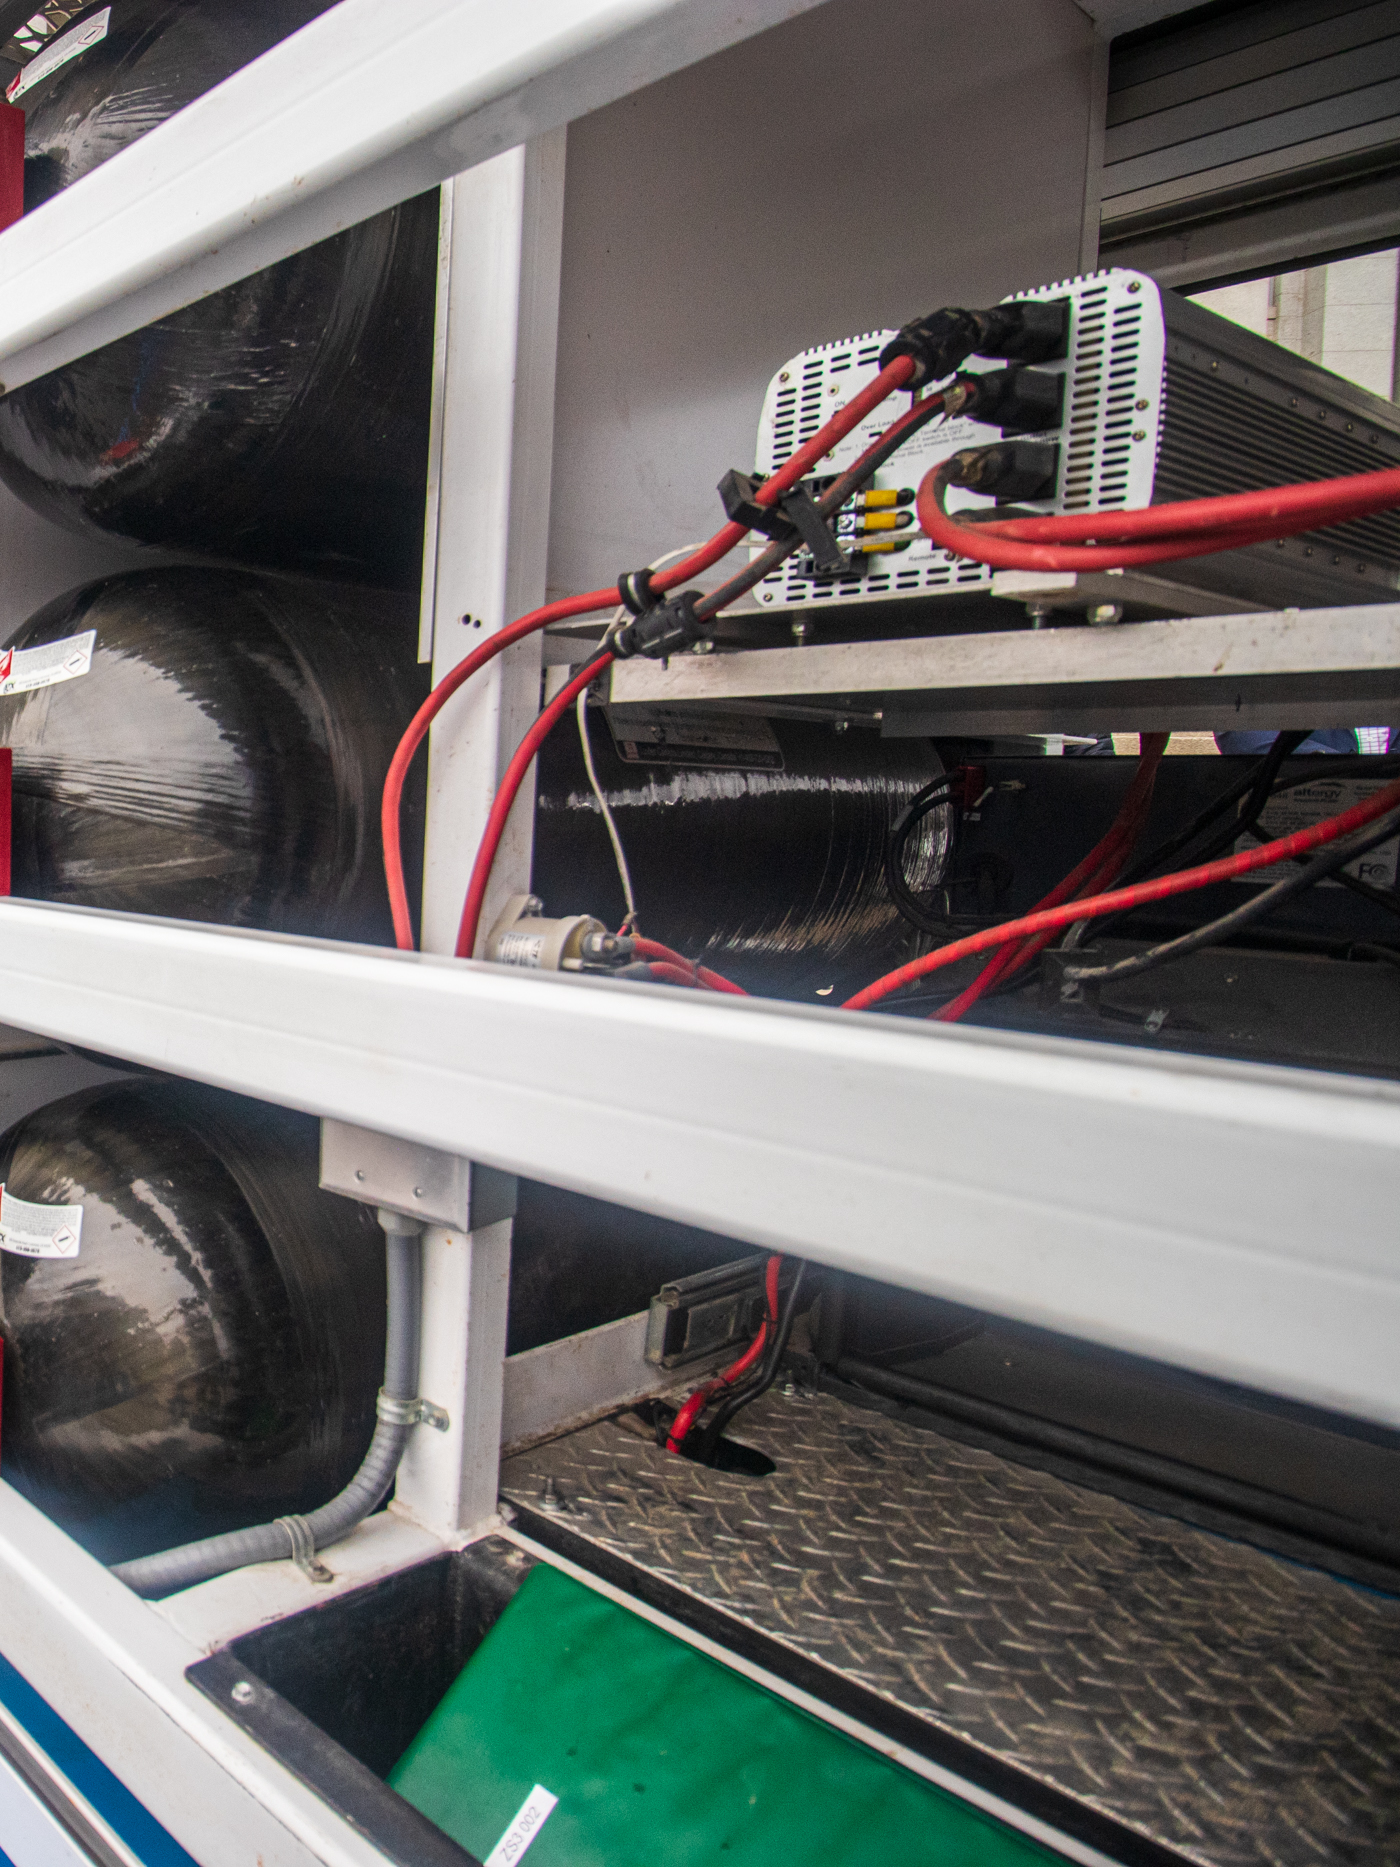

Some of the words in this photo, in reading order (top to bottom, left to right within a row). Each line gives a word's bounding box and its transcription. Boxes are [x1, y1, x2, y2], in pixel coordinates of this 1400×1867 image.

[1293, 787, 1341, 799] altergy
[500, 1833, 523, 1862] ZS3
[519, 1806, 541, 1832] 002
